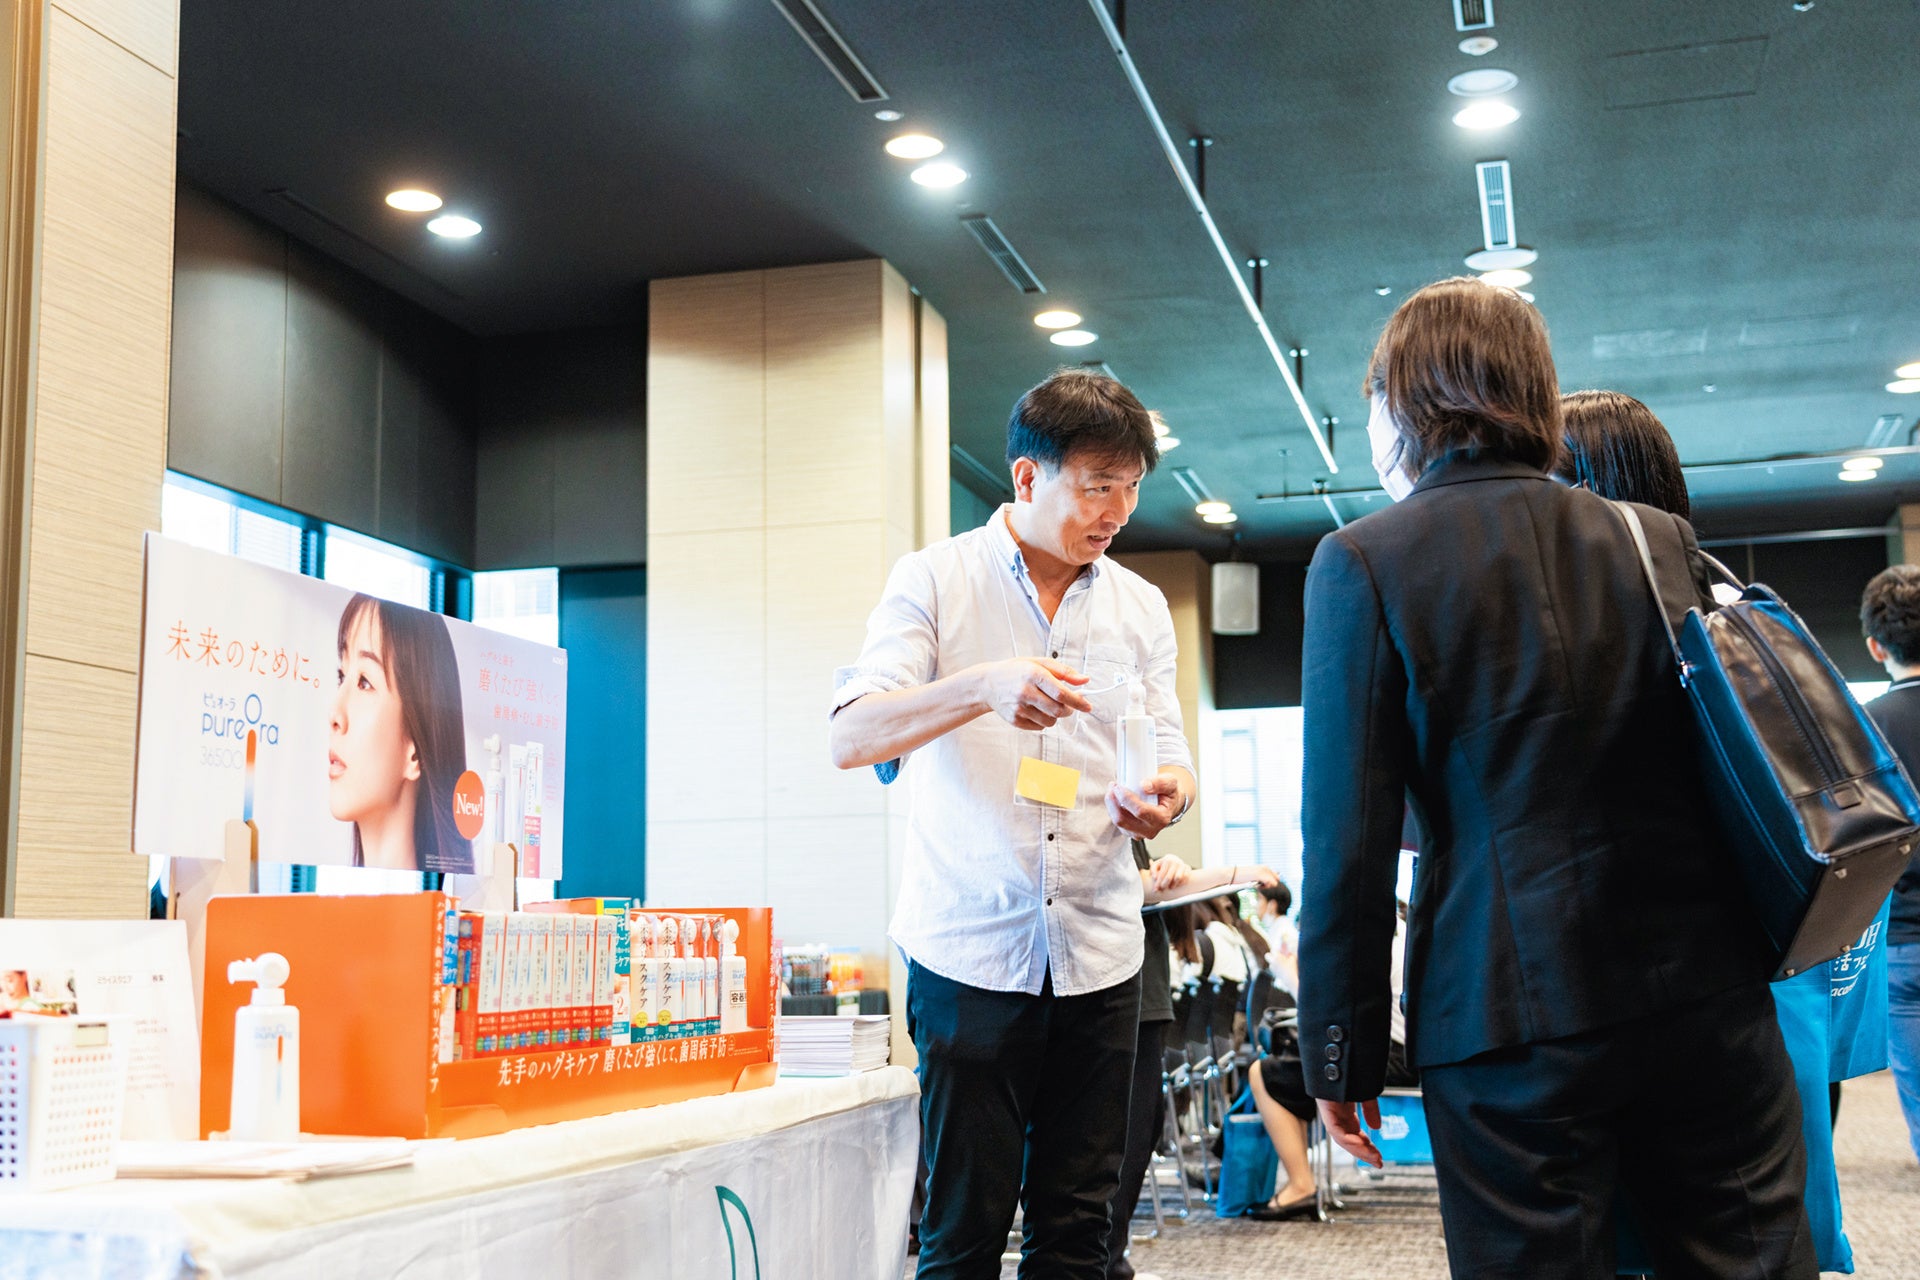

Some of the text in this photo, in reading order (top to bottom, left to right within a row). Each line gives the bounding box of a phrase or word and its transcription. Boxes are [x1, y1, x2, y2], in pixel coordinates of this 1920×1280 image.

[165, 618, 321, 689] 未来のために。
[201, 692, 280, 746] pureOra
[455, 792, 484, 817] New!
[498, 1052, 598, 1086] 先手のハグキケア
[602, 1036, 728, 1074] 磨くたび強くして、歯周病予防
